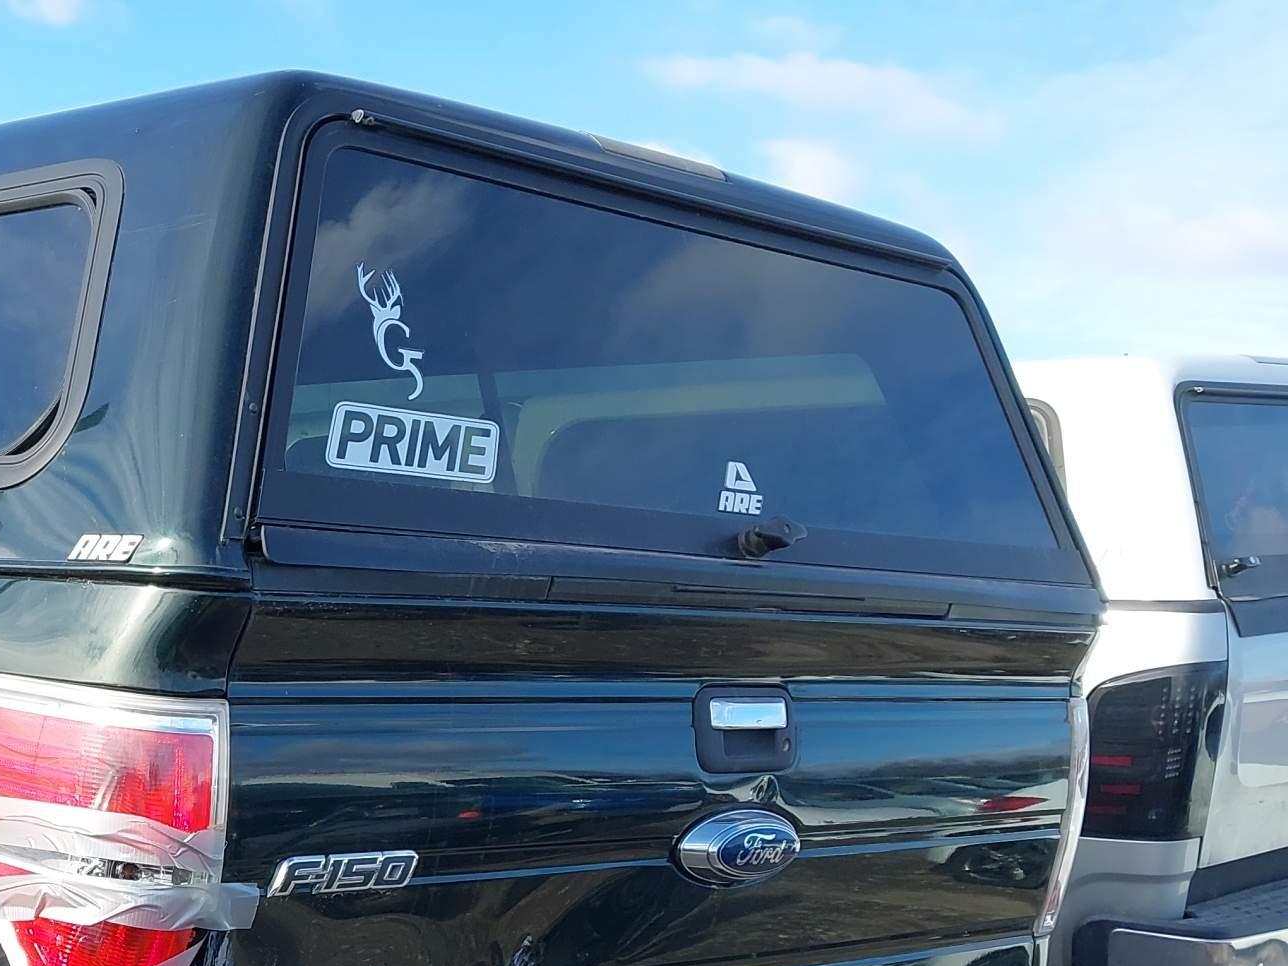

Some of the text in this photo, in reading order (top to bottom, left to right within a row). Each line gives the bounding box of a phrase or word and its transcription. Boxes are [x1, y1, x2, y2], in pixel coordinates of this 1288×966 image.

[335, 408, 492, 476] PRIME
[718, 490, 763, 515] ARE
[67, 533, 144, 562] ARE
[736, 832, 787, 867] Ford
